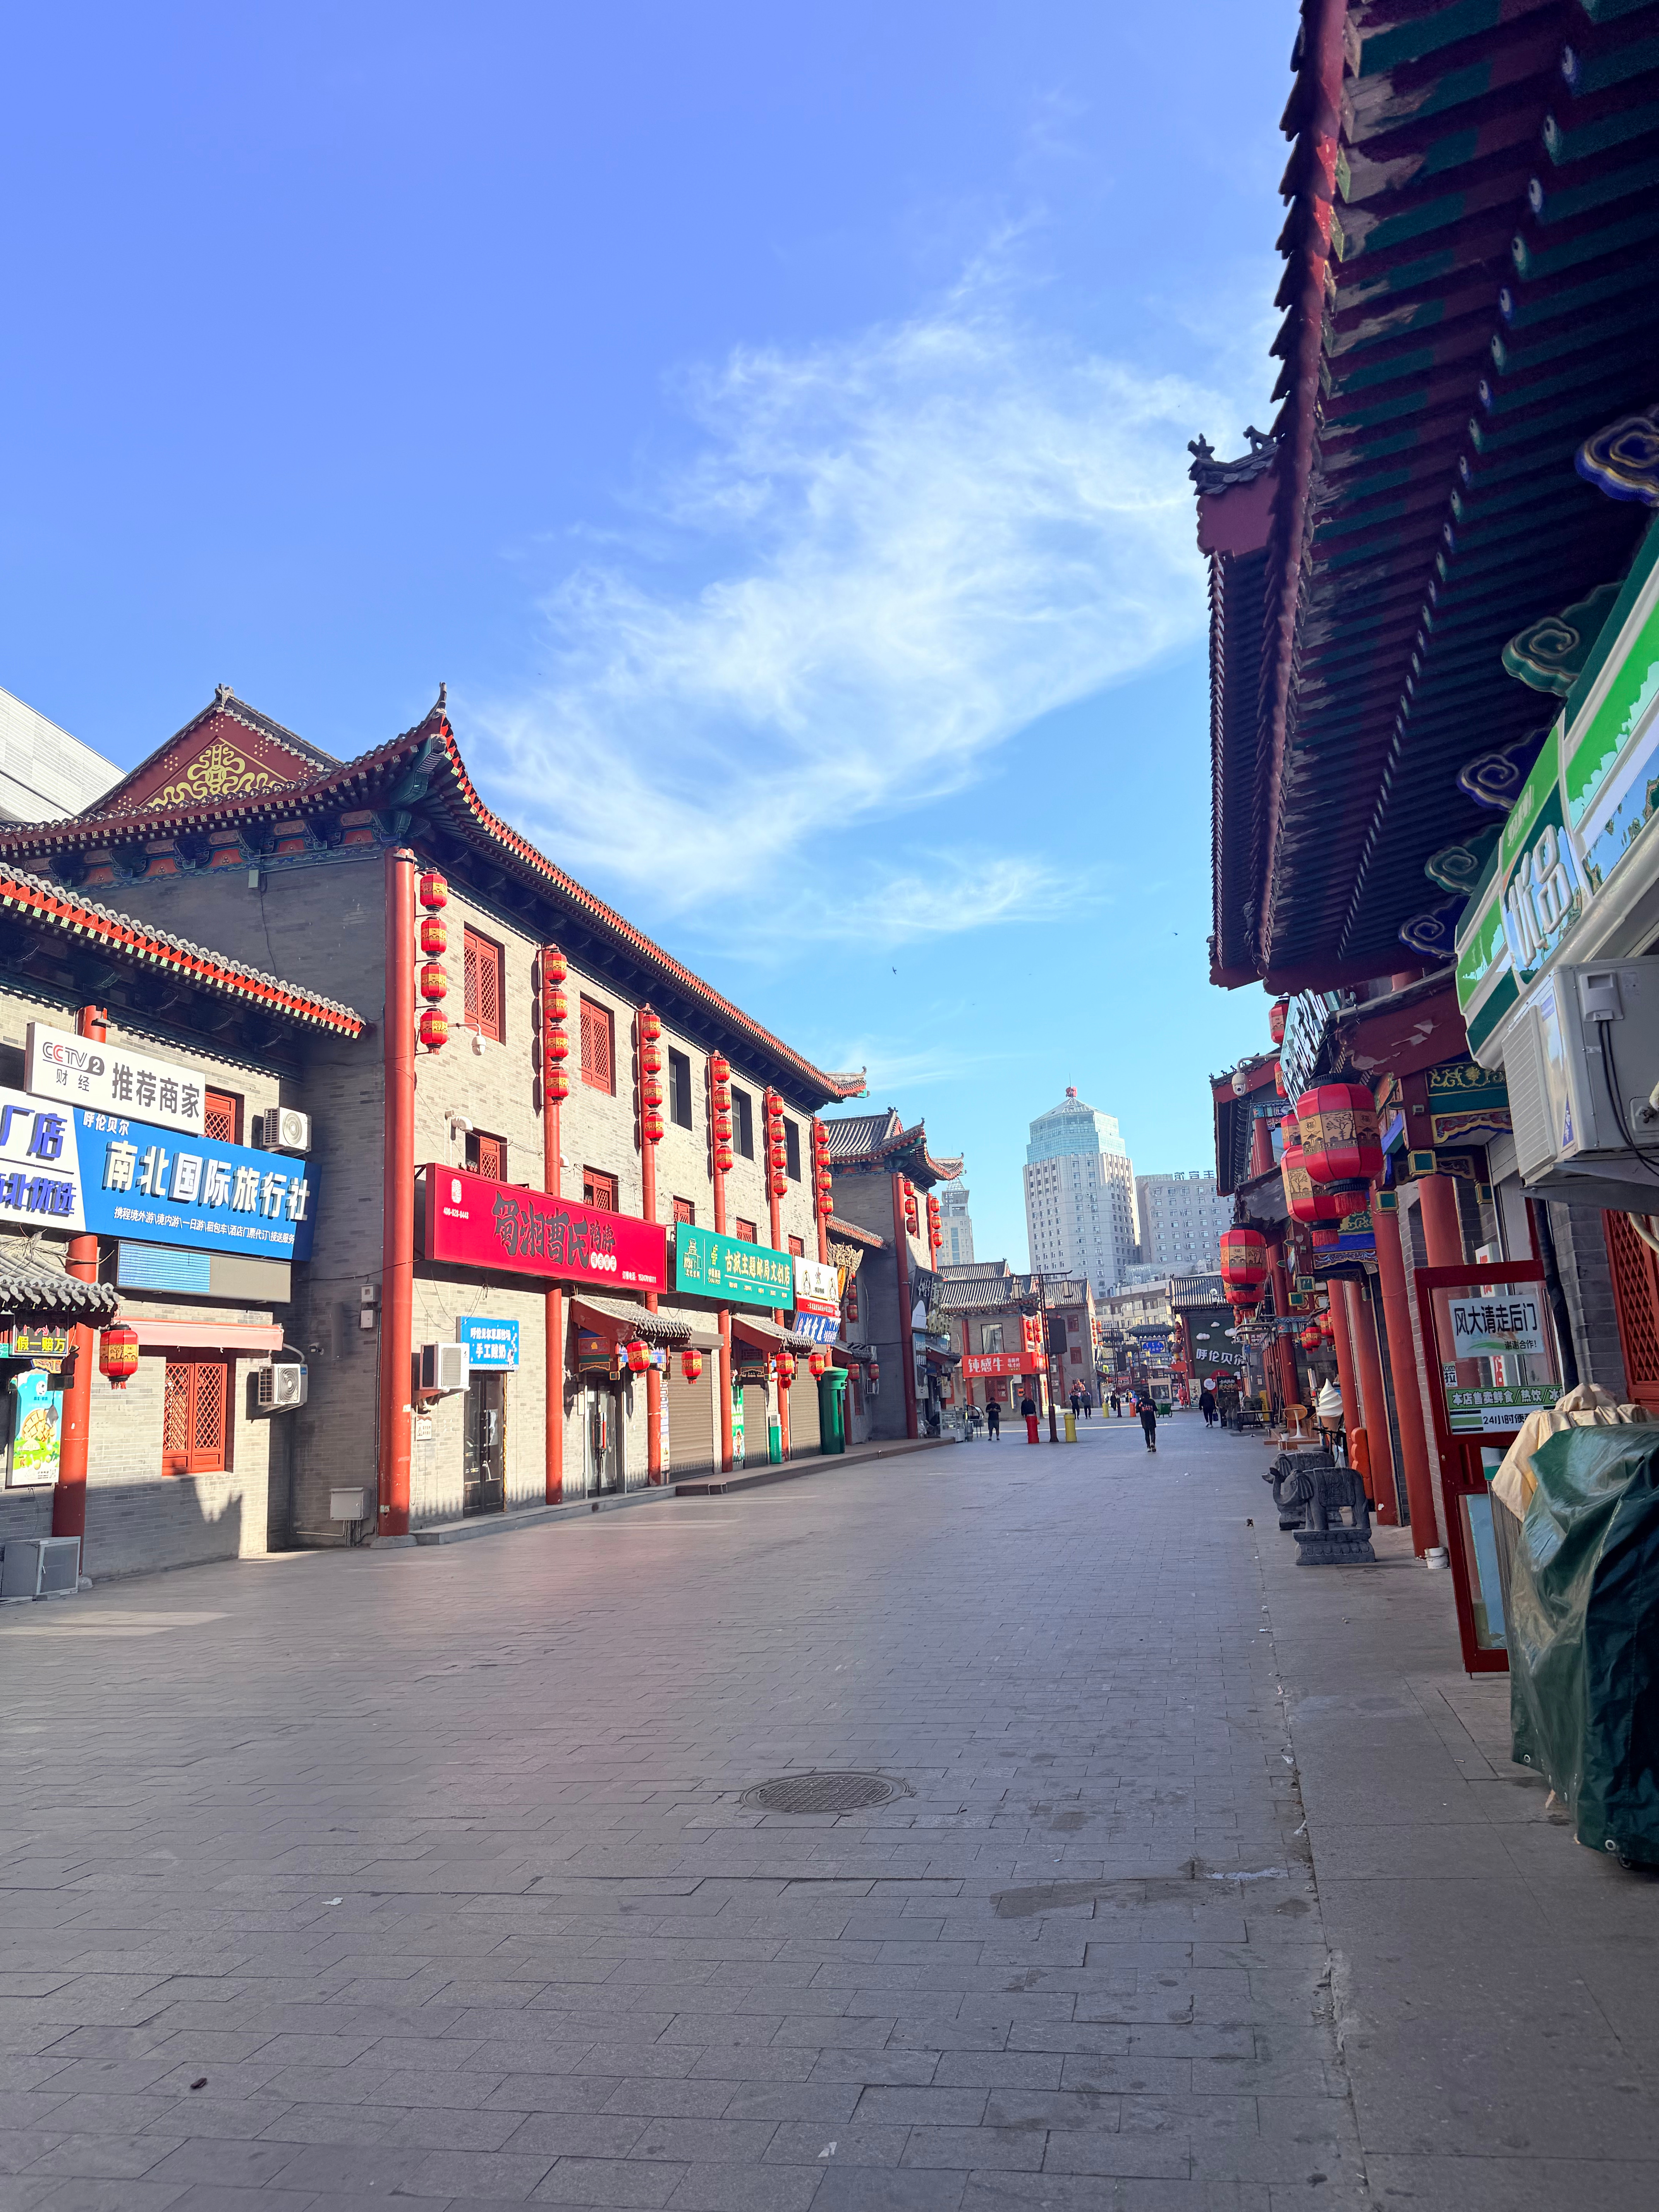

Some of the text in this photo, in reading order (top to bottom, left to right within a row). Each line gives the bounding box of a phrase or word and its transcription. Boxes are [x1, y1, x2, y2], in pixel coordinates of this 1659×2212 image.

[56, 1069, 90, 1092] 财经
[112, 1062, 200, 1119] 推荐商家
[82, 1111, 129, 1135] 呼伦贝尔
[101, 1140, 310, 1222] 南北国际旅行社
[0, 1173, 76, 1217] 北优选
[725, 1249, 790, 1287] 古城主题邮局文创店
[1454, 1303, 1537, 1336] 风大请走后门
[17, 1336, 66, 1352] 假一赔万
[476, 1343, 506, 1359] 手工酸奶
[968, 1357, 1004, 1372] 钝感牛
[1444, 1372, 1456, 1383] 拉
